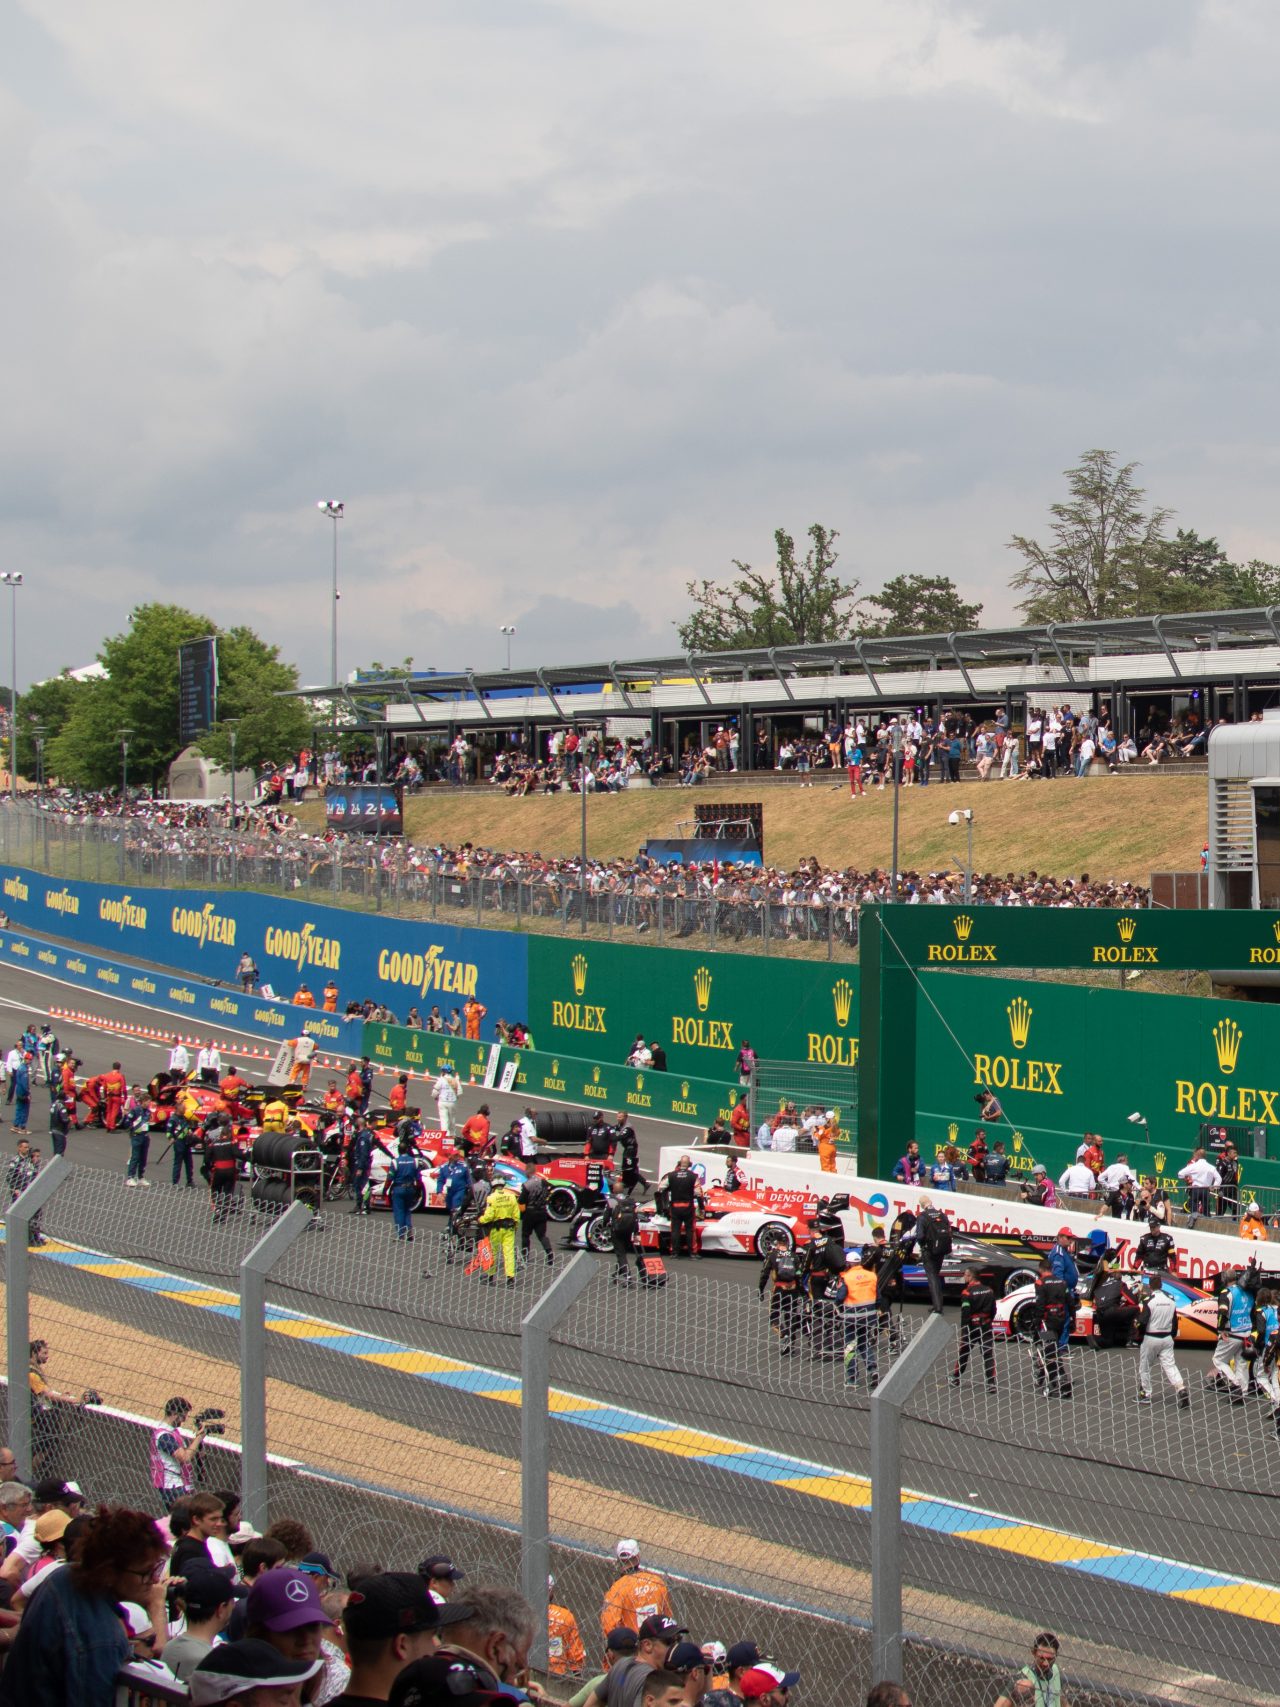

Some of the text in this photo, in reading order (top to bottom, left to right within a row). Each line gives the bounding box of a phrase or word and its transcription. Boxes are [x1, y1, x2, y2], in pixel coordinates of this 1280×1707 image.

[927, 945, 997, 961] ROLEX
[1092, 946, 1158, 963] ROLEX
[552, 1001, 607, 1032] ROLEX
[672, 1017, 734, 1050] ROLEX
[405, 1050, 424, 1063] ROLEX
[807, 1033, 859, 1066] ROLE
[974, 1054, 1063, 1095] ROLEX
[543, 1077, 566, 1092] ROLEX
[584, 1084, 607, 1099] ROLEX
[627, 1092, 651, 1107] ROLEX
[1175, 1080, 1280, 1126] ROLEX
[672, 1100, 697, 1115] ROLEX
[719, 1108, 734, 1121] ROL
[422, 1131, 442, 1140] ENSO
[1004, 1155, 1034, 1170] OLEX
[769, 1193, 804, 1203] DENSO
[647, 1232, 654, 1244] 7
[1203, 1281, 1213, 1289] HY
[1075, 1319, 1086, 1334] 5
